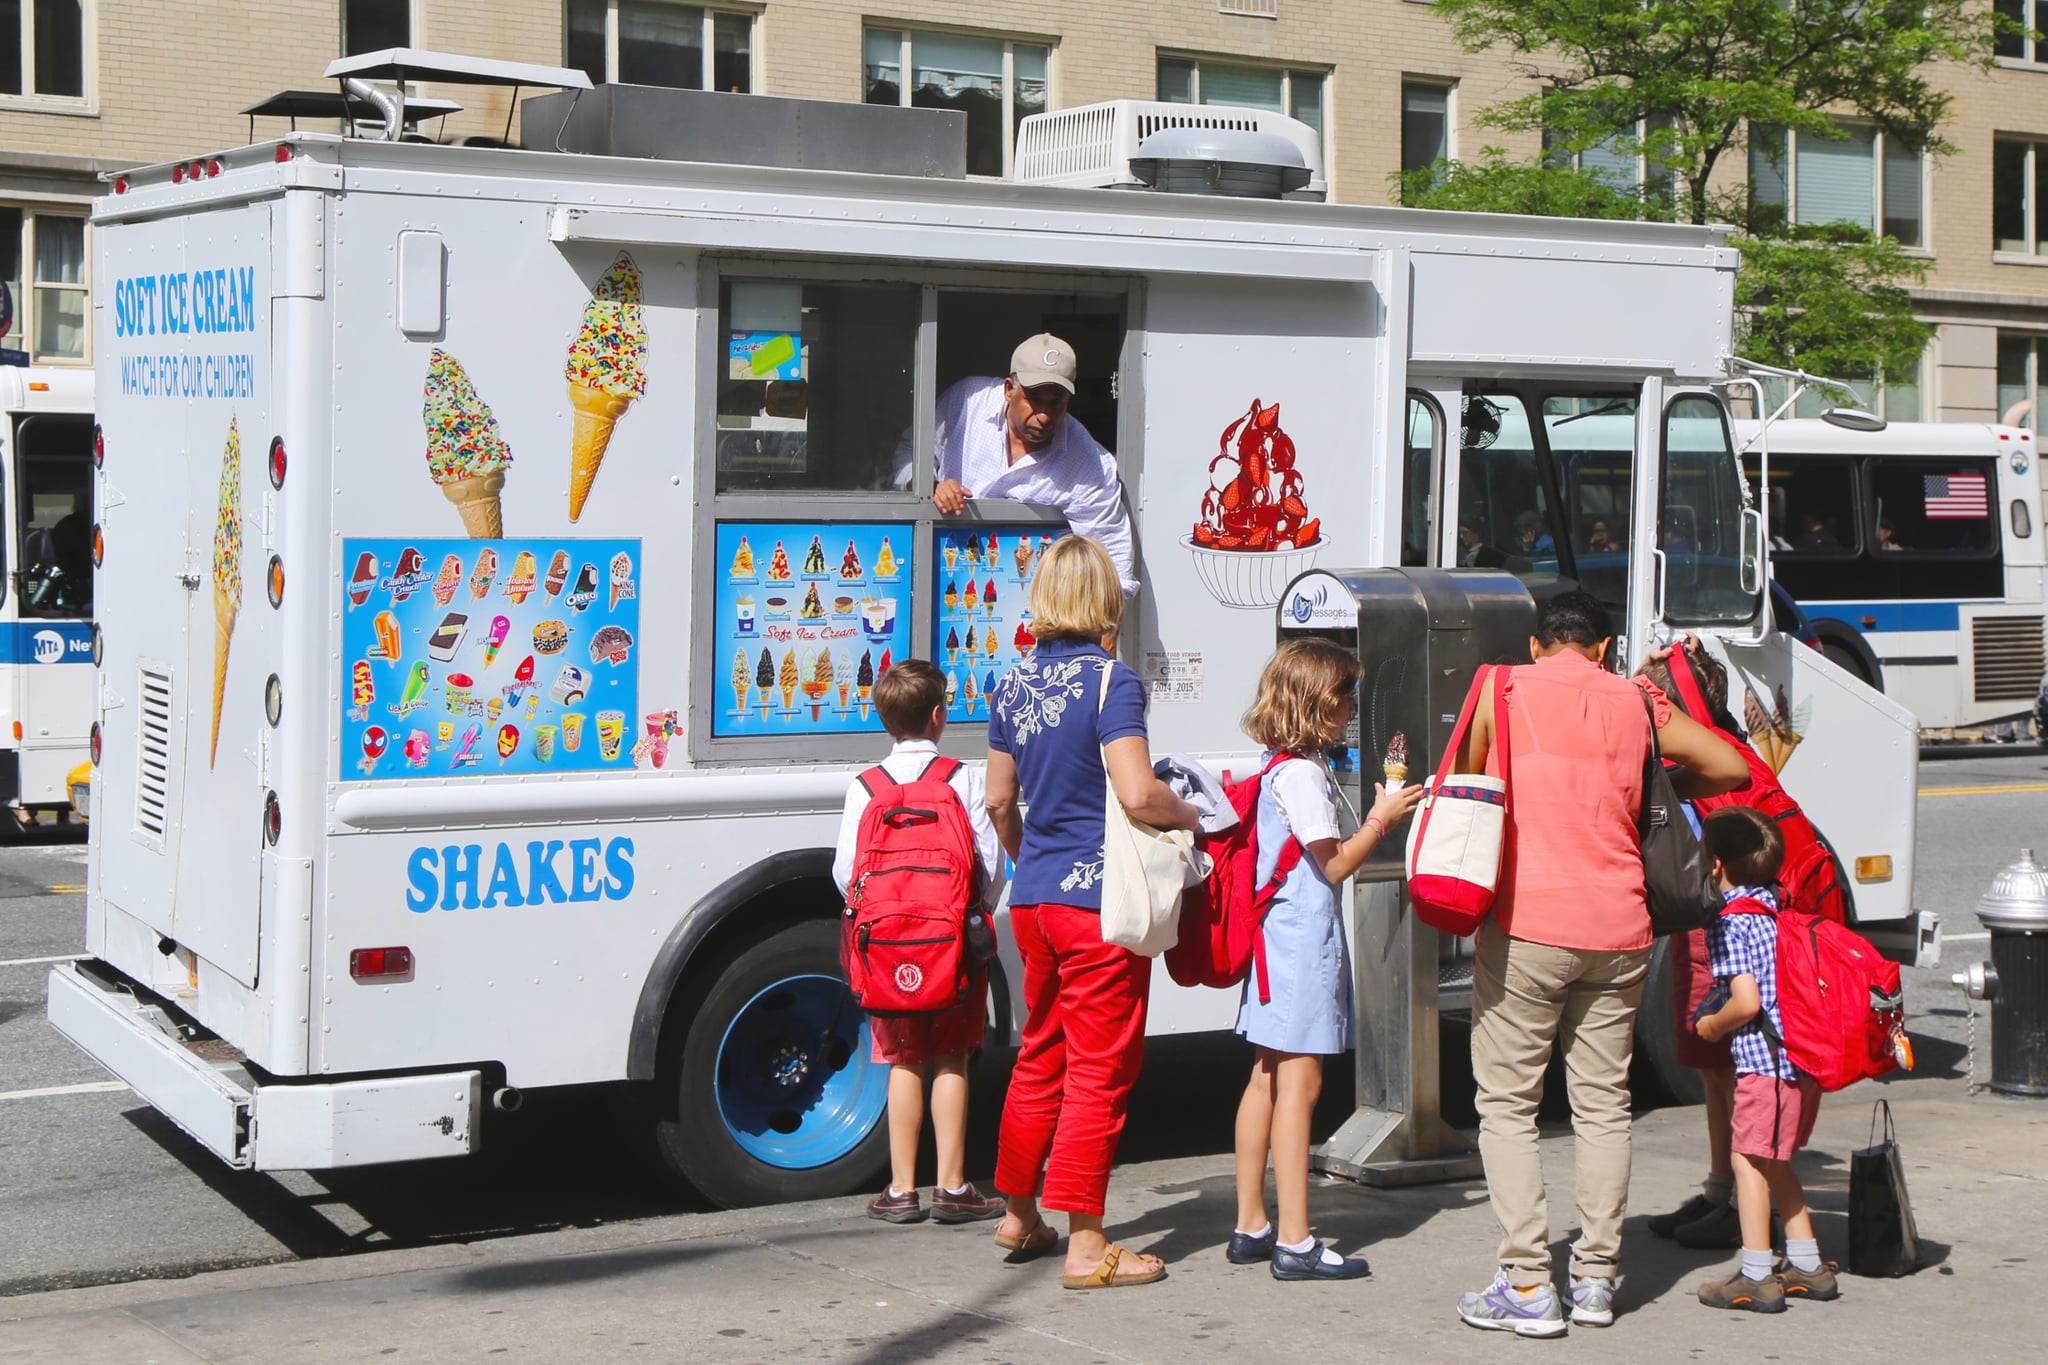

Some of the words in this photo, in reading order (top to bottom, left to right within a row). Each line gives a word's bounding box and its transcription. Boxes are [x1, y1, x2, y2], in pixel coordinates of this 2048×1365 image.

[115, 277, 156, 338] SOFT
[160, 273, 190, 333] ICE
[193, 265, 255, 333] CREAM
[1043, 349, 1060, 366] C
[121, 355, 156, 397] WATCH
[160, 355, 179, 397] FOR
[182, 355, 203, 398] OUR
[207, 354, 254, 399] CHILDREN
[618, 589, 635, 598] CONE
[619, 581, 634, 590] KING
[566, 591, 597, 606] OREO
[762, 625, 792, 643] Soft
[796, 627, 816, 641] Ice
[820, 626, 858, 640] Cream
[34, 637, 59, 656] MTA
[69, 639, 92, 652] Ne
[1154, 682, 1172, 692] 2014
[1176, 682, 1194, 692] 2015
[406, 836, 635, 913] SHAKES
